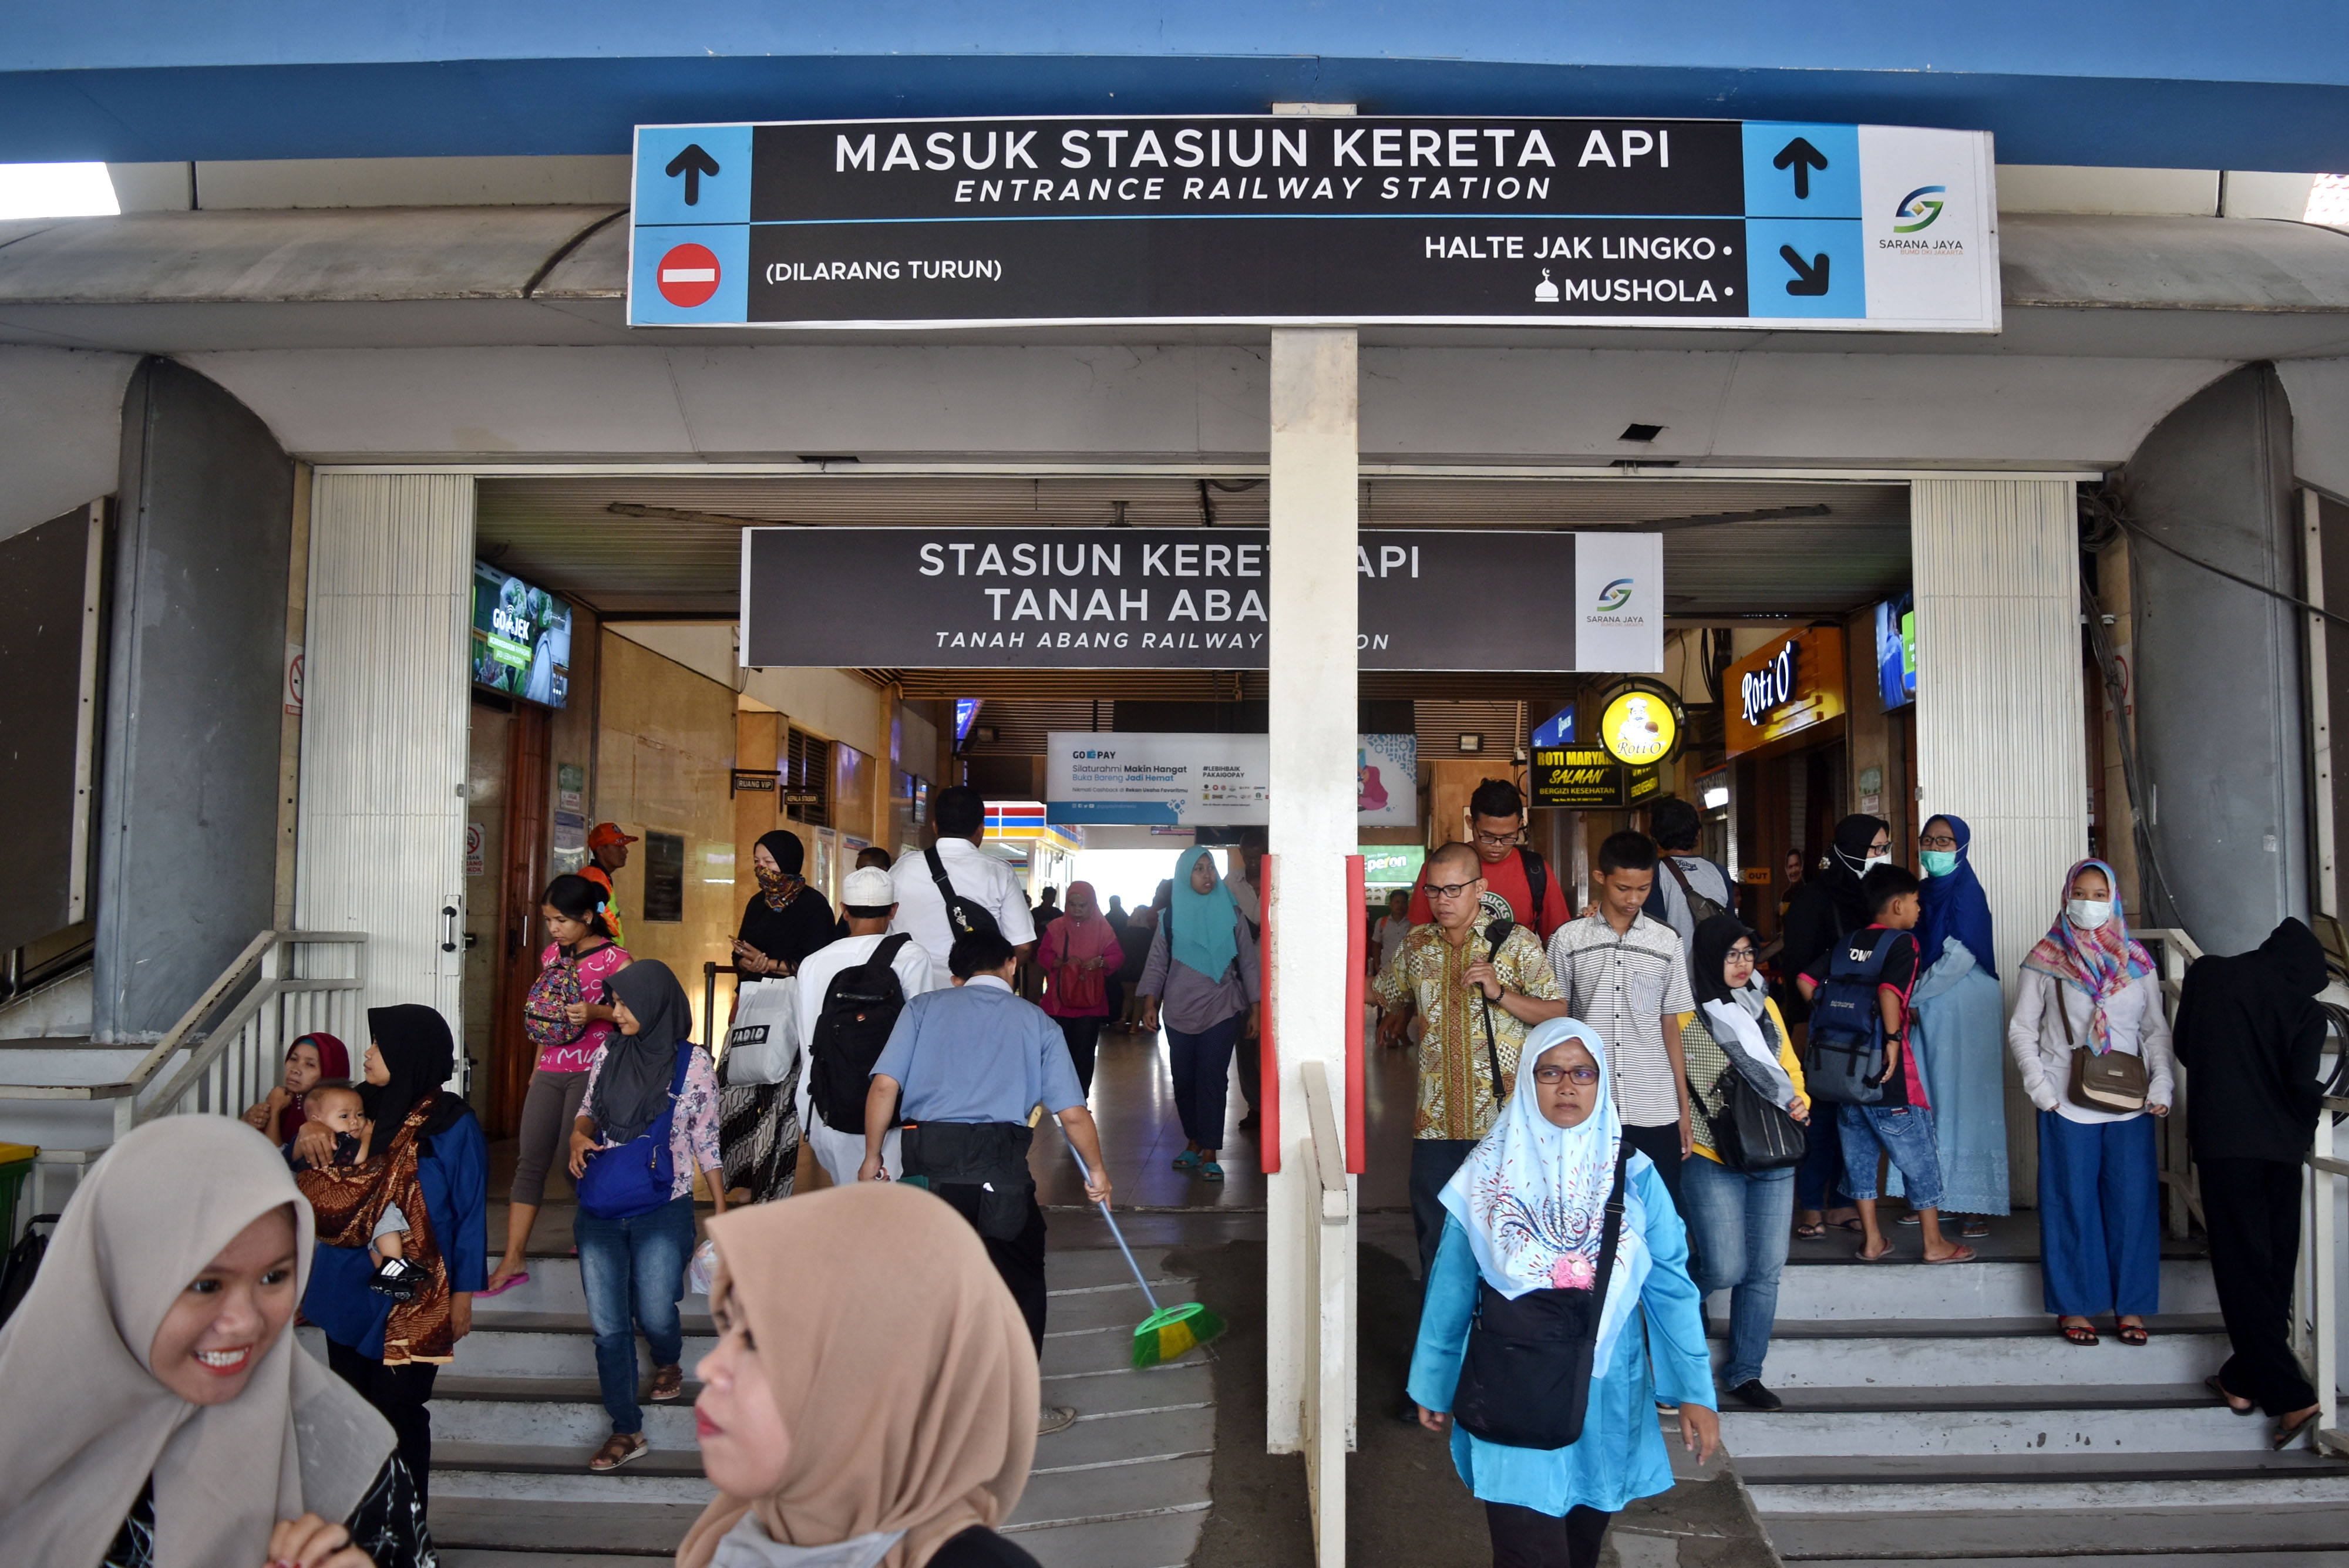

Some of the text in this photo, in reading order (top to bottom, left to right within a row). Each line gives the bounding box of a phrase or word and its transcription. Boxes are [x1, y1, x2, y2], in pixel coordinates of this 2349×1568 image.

[836, 129, 1669, 172] MASUK STASIUN KERETA API
[954, 177, 1550, 203] ENTRANCE RAILWAY STATION
[1425, 236, 1715, 260] HALTE JAK LINGKO
[1879, 240, 1963, 249] SARANA JAYA
[766, 260, 1002, 285] (DILARANG TURUN)
[1565, 278, 1717, 302] MUSHOLA
[918, 543, 1120, 576] STASIUN
[1143, 544, 1269, 577] KERE
[984, 588, 1268, 621] TANAH ABA
[493, 608, 506, 630] GO
[936, 632, 1263, 649] TANAH ABANG RAILWAY
[1153, 766, 1187, 775] Hangat
[1537, 752, 1564, 766] ROTI
[738, 780, 760, 788] RUANG
[1094, 775, 1123, 783] Bareng
[1549, 769, 1605, 784] SALMAN
[1479, 894, 1510, 919] BUCKS
